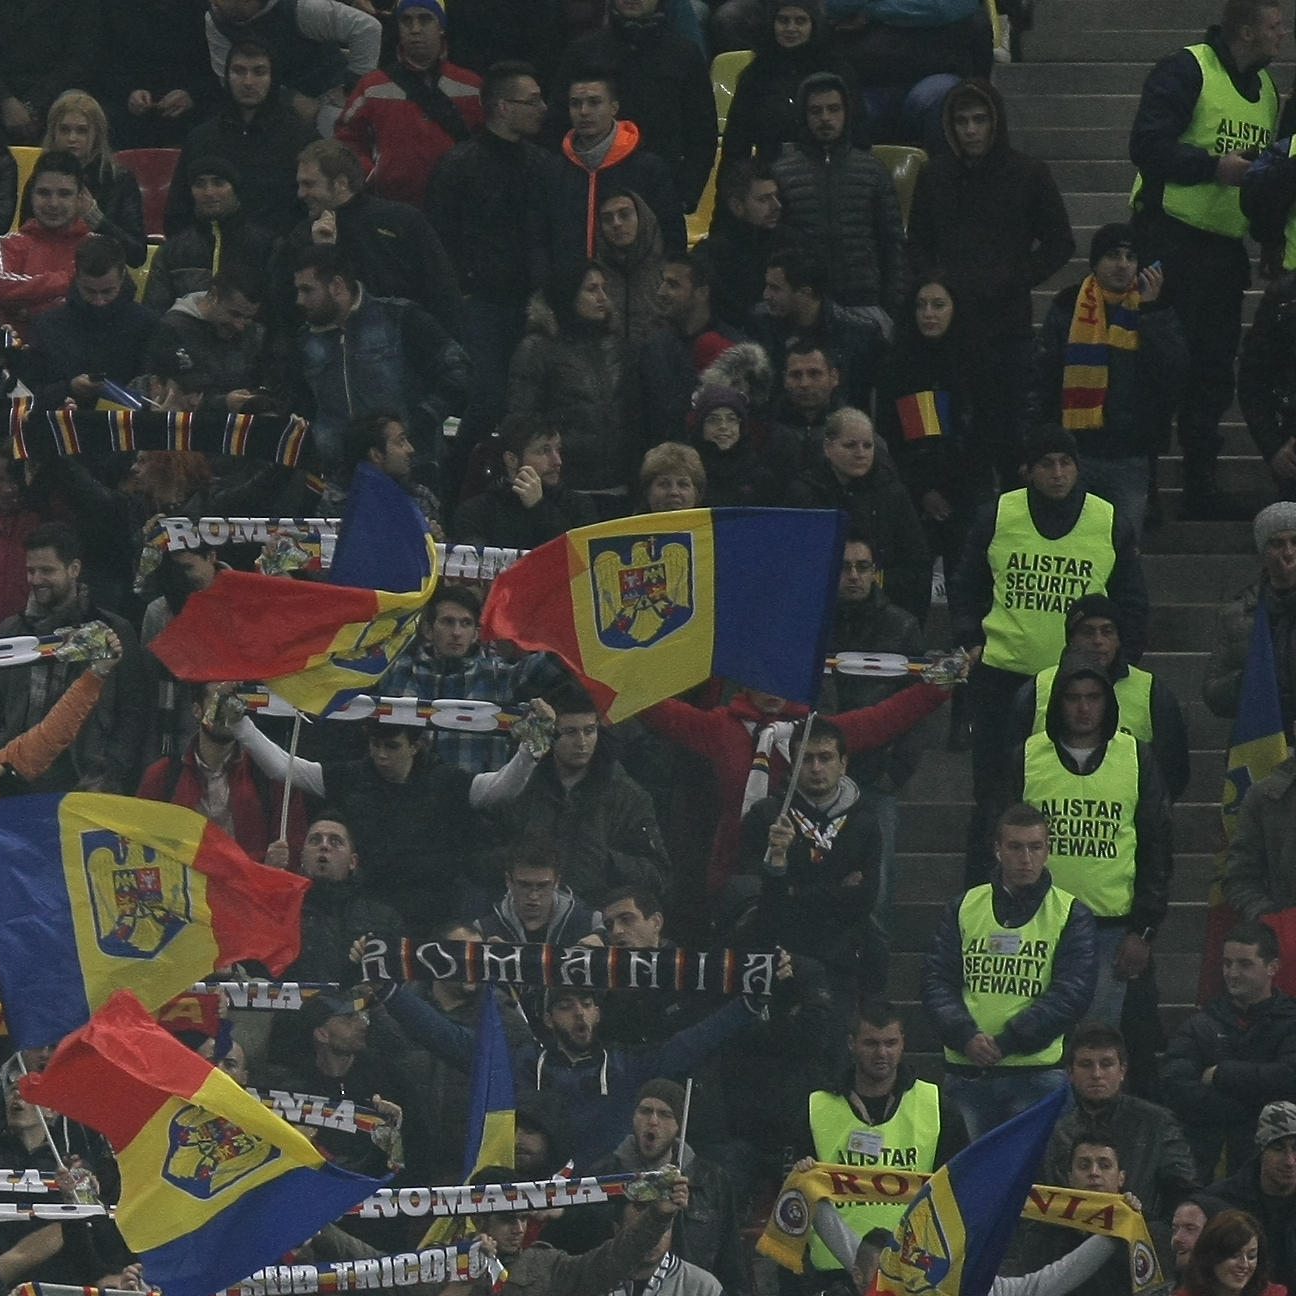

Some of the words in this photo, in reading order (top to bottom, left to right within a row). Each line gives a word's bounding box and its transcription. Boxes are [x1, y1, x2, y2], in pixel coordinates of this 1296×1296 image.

[1008, 552, 1093, 577] ALISTAR
[1006, 572, 1091, 597] SECURITY
[1048, 819, 1119, 841] ECURITY
[1049, 839, 1117, 859] TEWARD
[965, 939, 1049, 958] ALAR
[361, 938, 775, 997] ROMANIA
[964, 957, 1047, 978] SECURITY
[359, 1175, 609, 1219] ROMANIA
